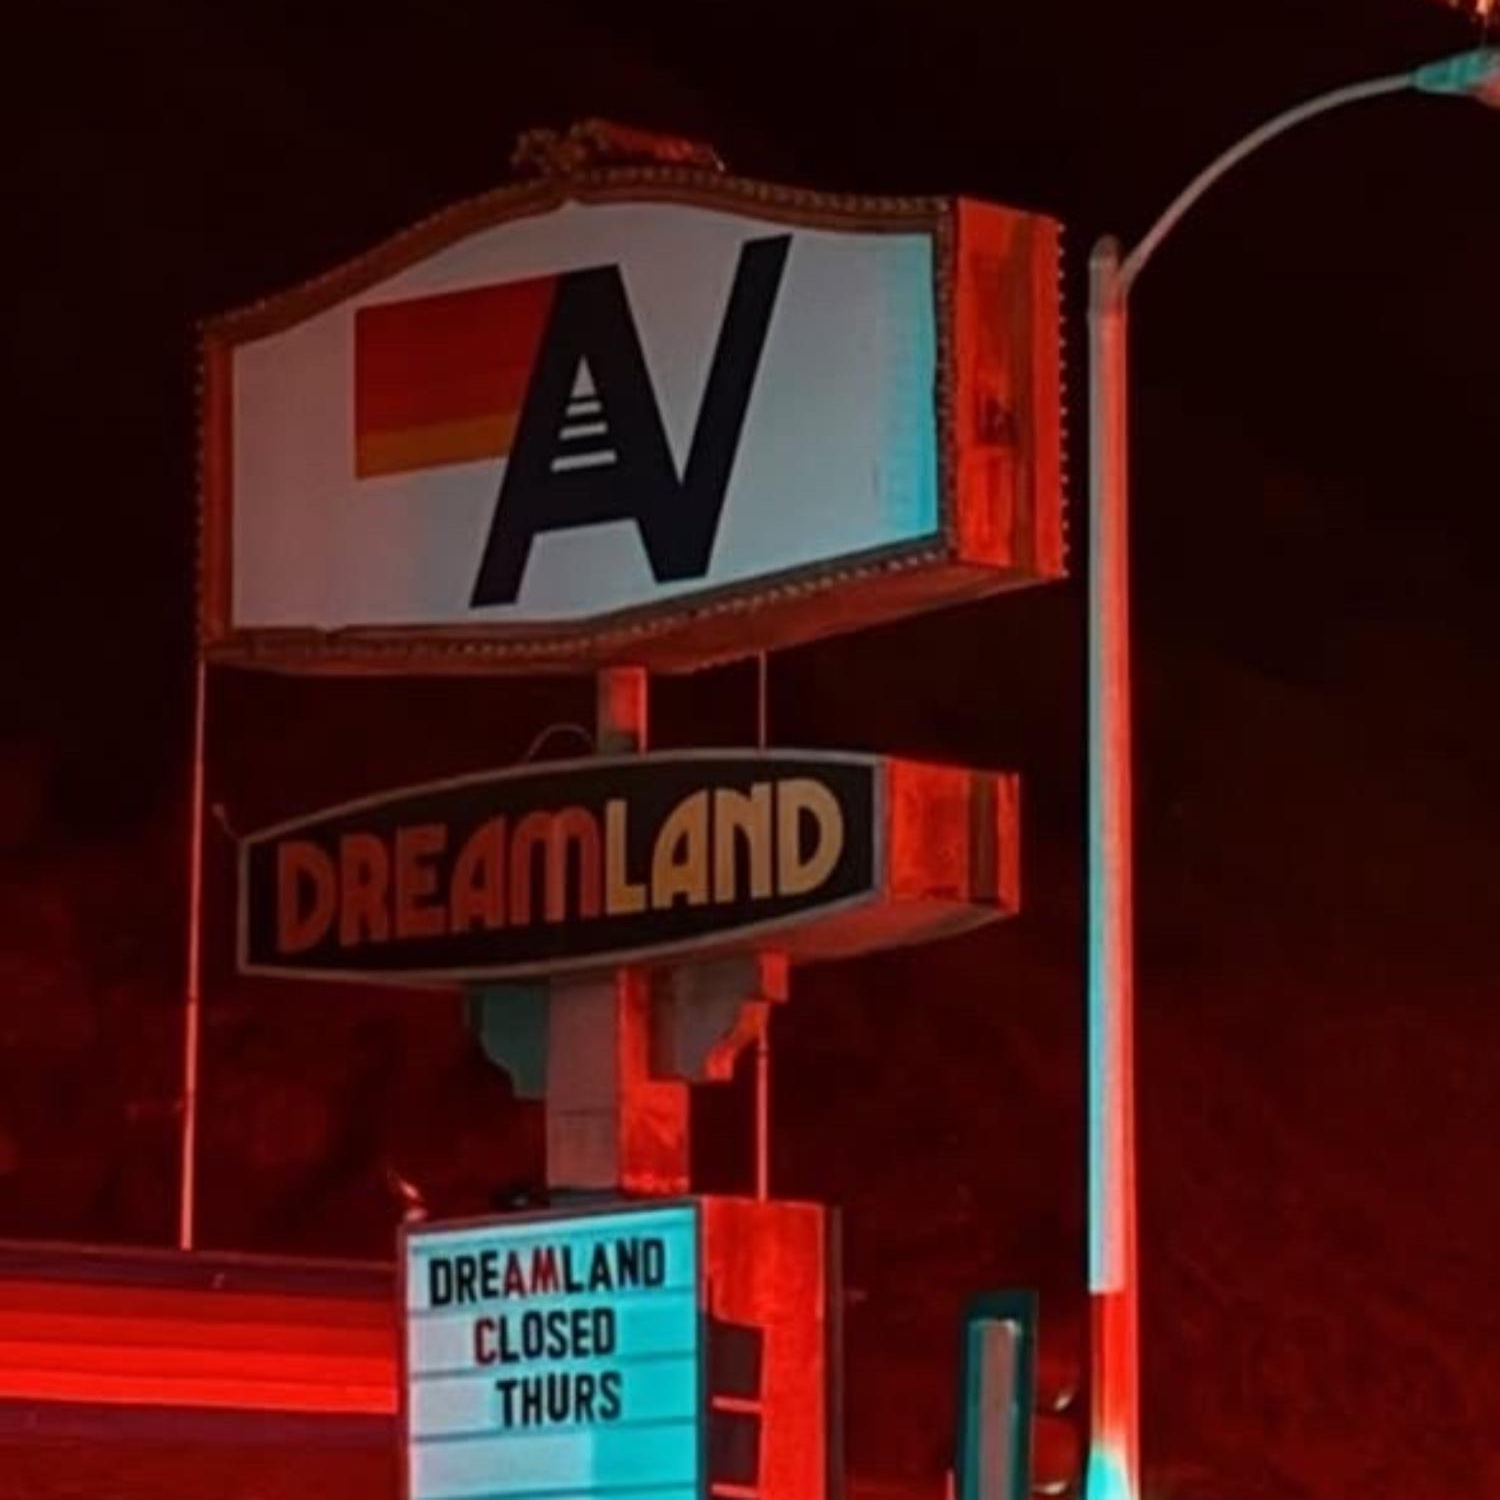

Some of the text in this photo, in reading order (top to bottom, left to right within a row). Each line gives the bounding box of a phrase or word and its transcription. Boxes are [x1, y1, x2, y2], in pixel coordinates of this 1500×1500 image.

[468, 232, 794, 608] AV
[276, 777, 845, 954] DREAMLAND
[428, 1237, 666, 1307] DREAMLAND
[474, 1306, 616, 1366] CLOSED
[495, 1370, 623, 1429] THURS
